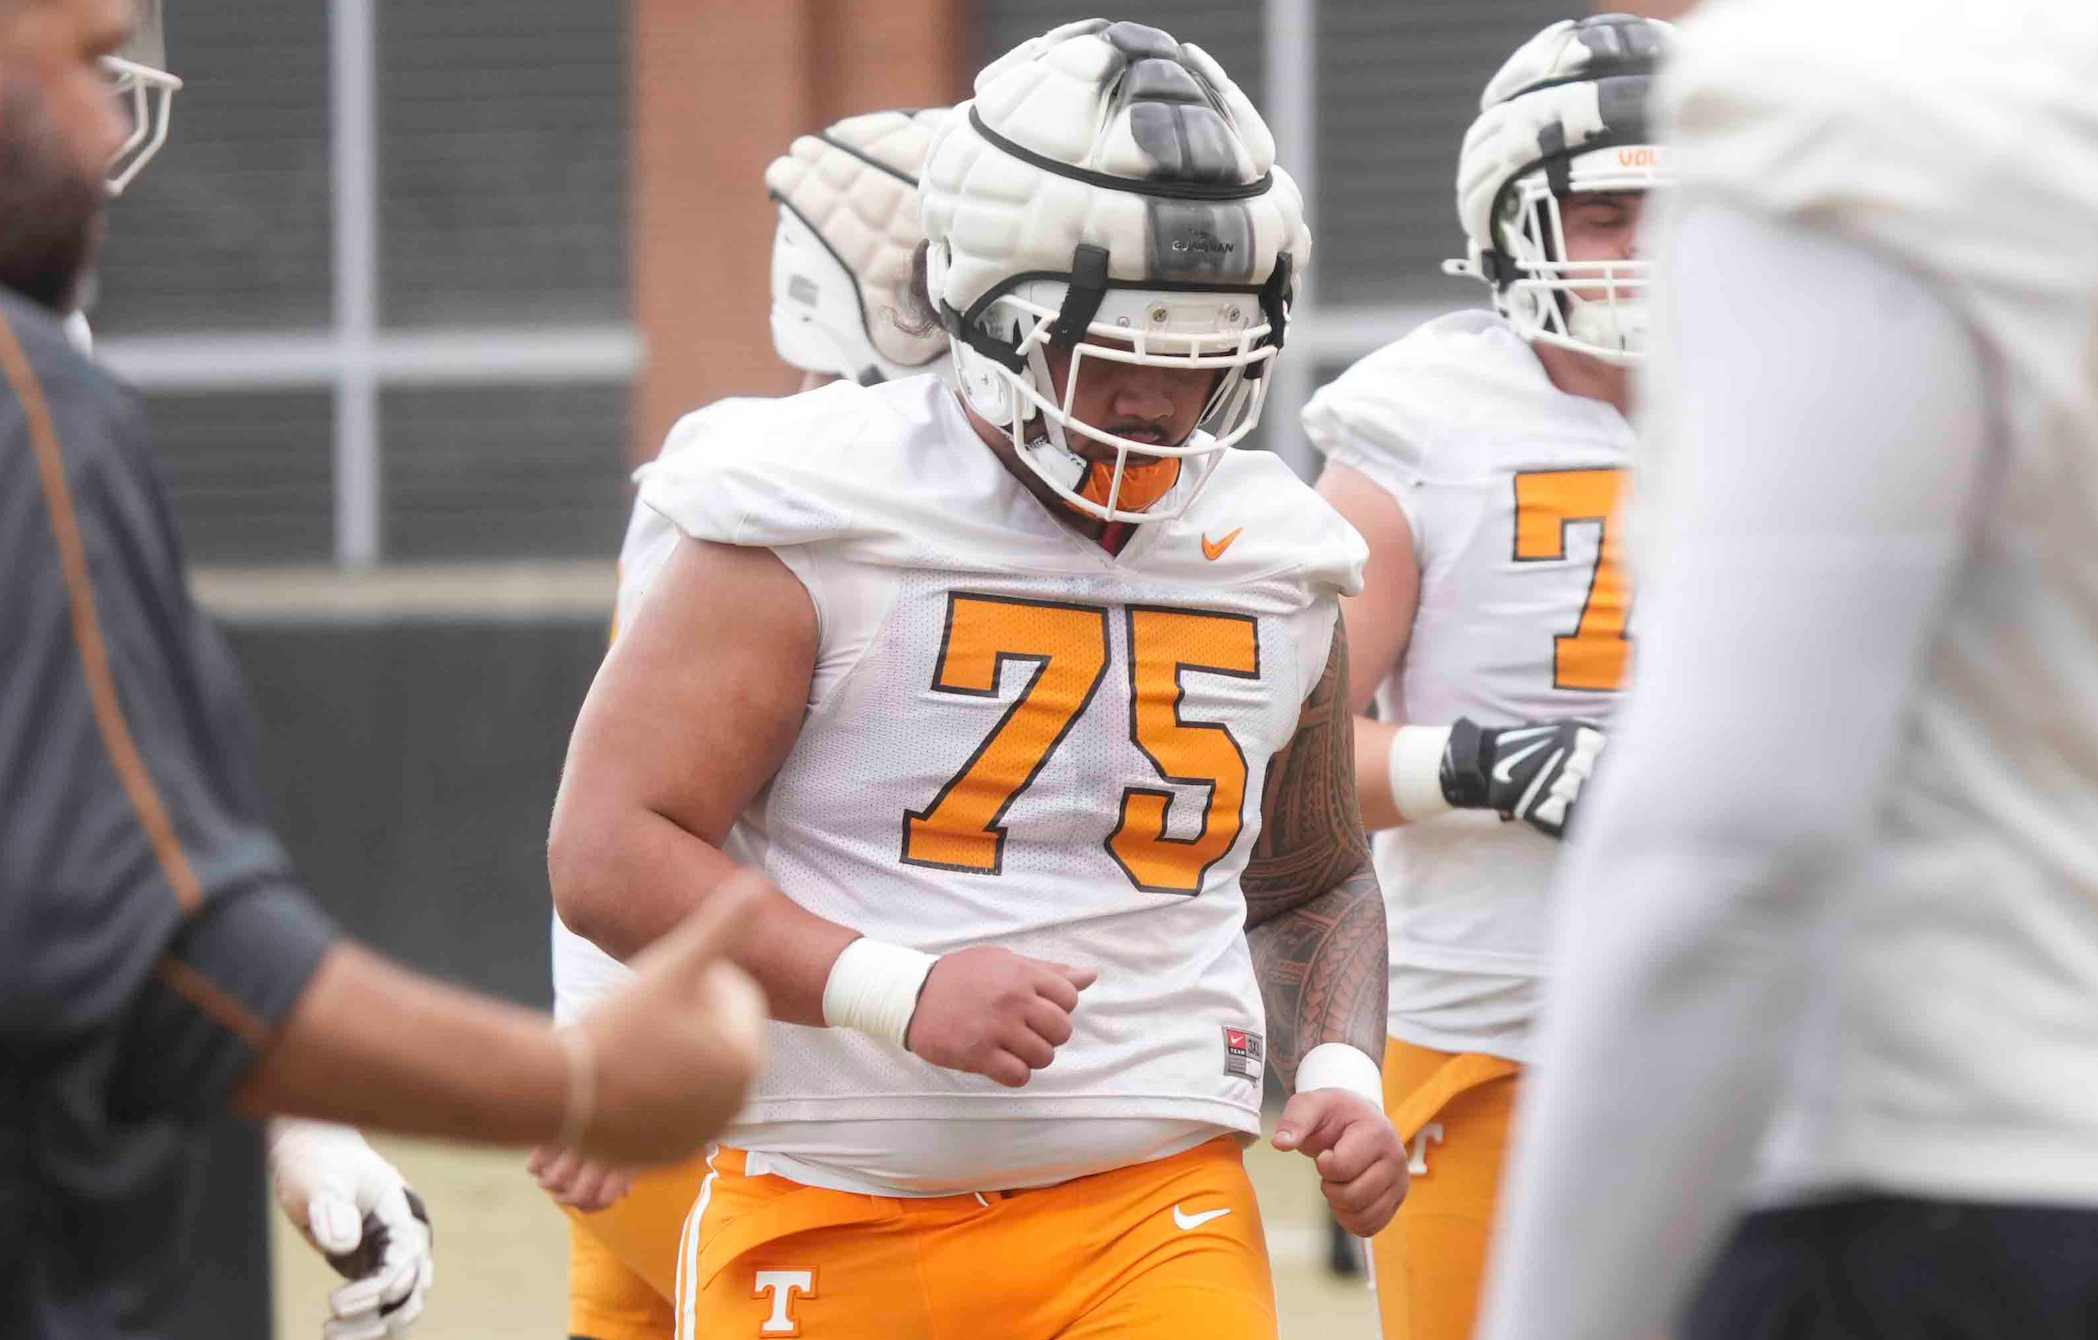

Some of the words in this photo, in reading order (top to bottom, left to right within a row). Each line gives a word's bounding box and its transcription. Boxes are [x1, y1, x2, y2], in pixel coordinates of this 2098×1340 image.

[899, 590, 1260, 897] 75
[1229, 1048, 1246, 1056] TEAM
[1247, 1038, 1260, 1058] 3XL
[753, 1269, 813, 1333] T
